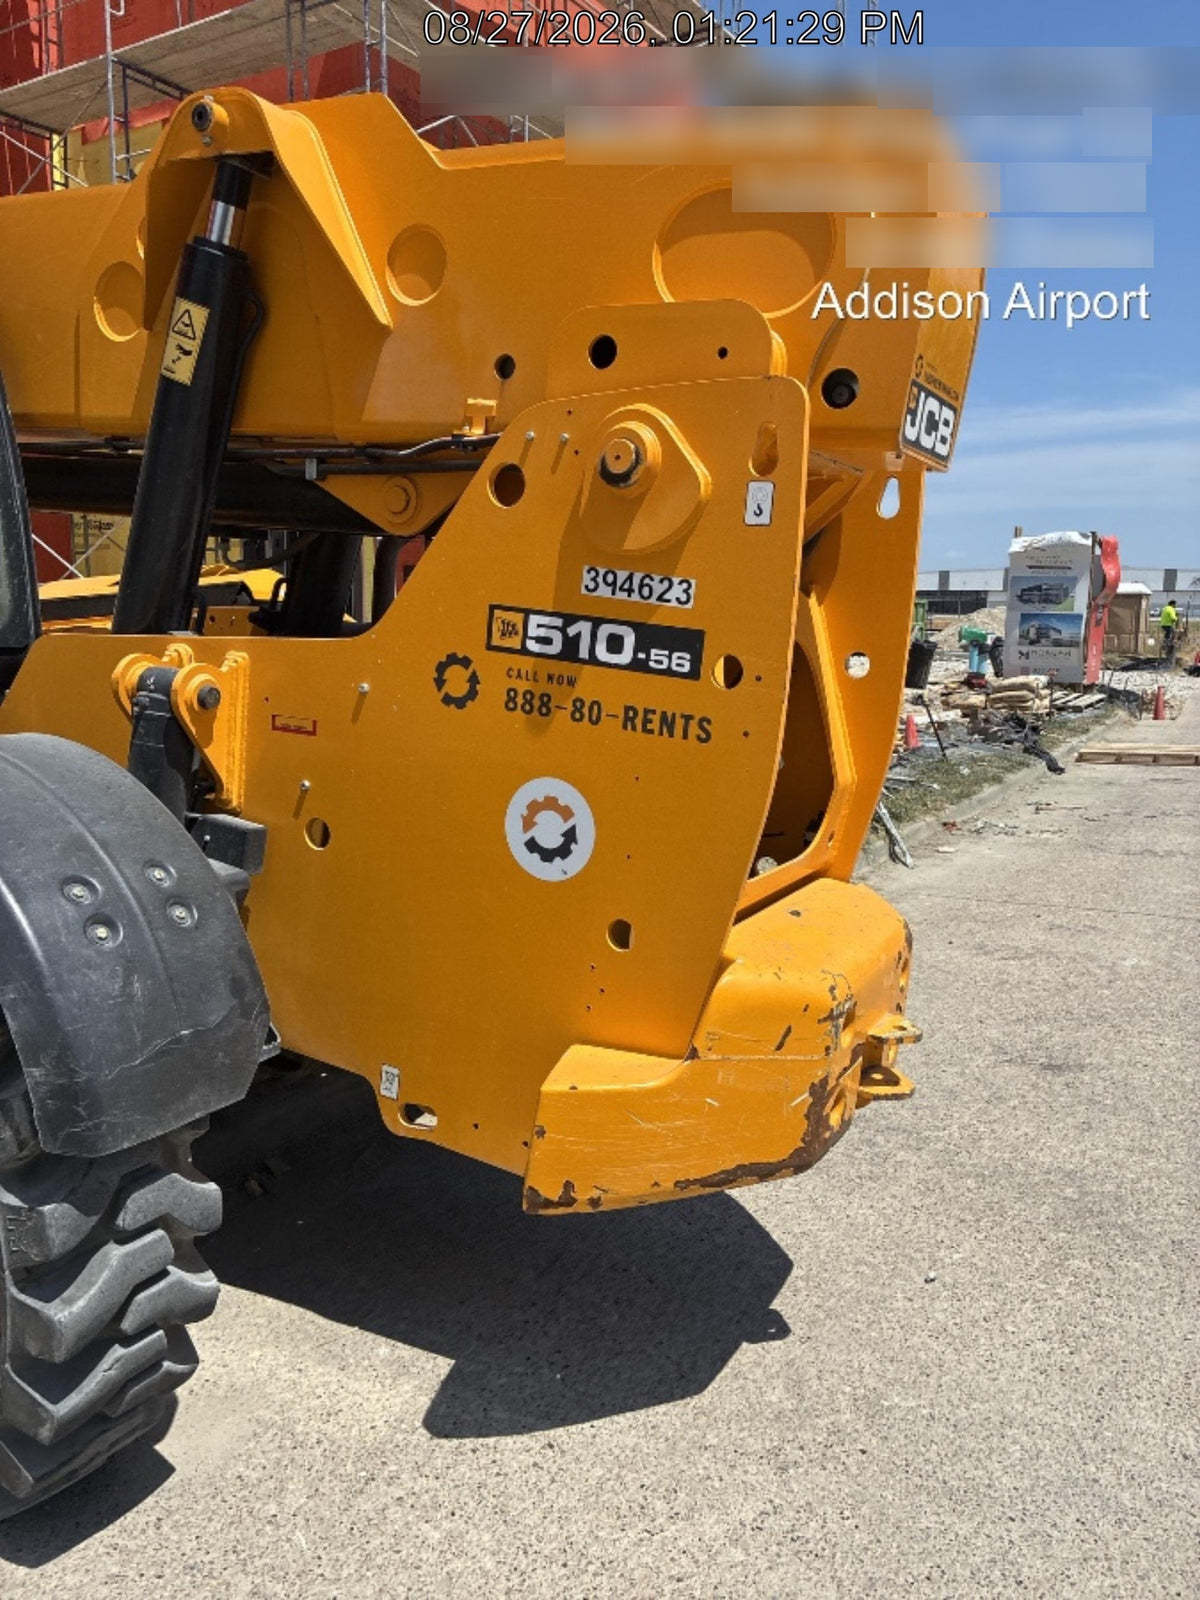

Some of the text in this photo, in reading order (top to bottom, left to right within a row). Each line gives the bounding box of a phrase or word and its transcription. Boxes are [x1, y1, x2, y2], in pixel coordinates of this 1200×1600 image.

[904, 391, 956, 457] JCB
[583, 566, 693, 606] 394623
[525, 614, 692, 673] 510-56
[506, 667, 577, 688] CALL NOW
[504, 687, 713, 744] 888-80-RENTS
